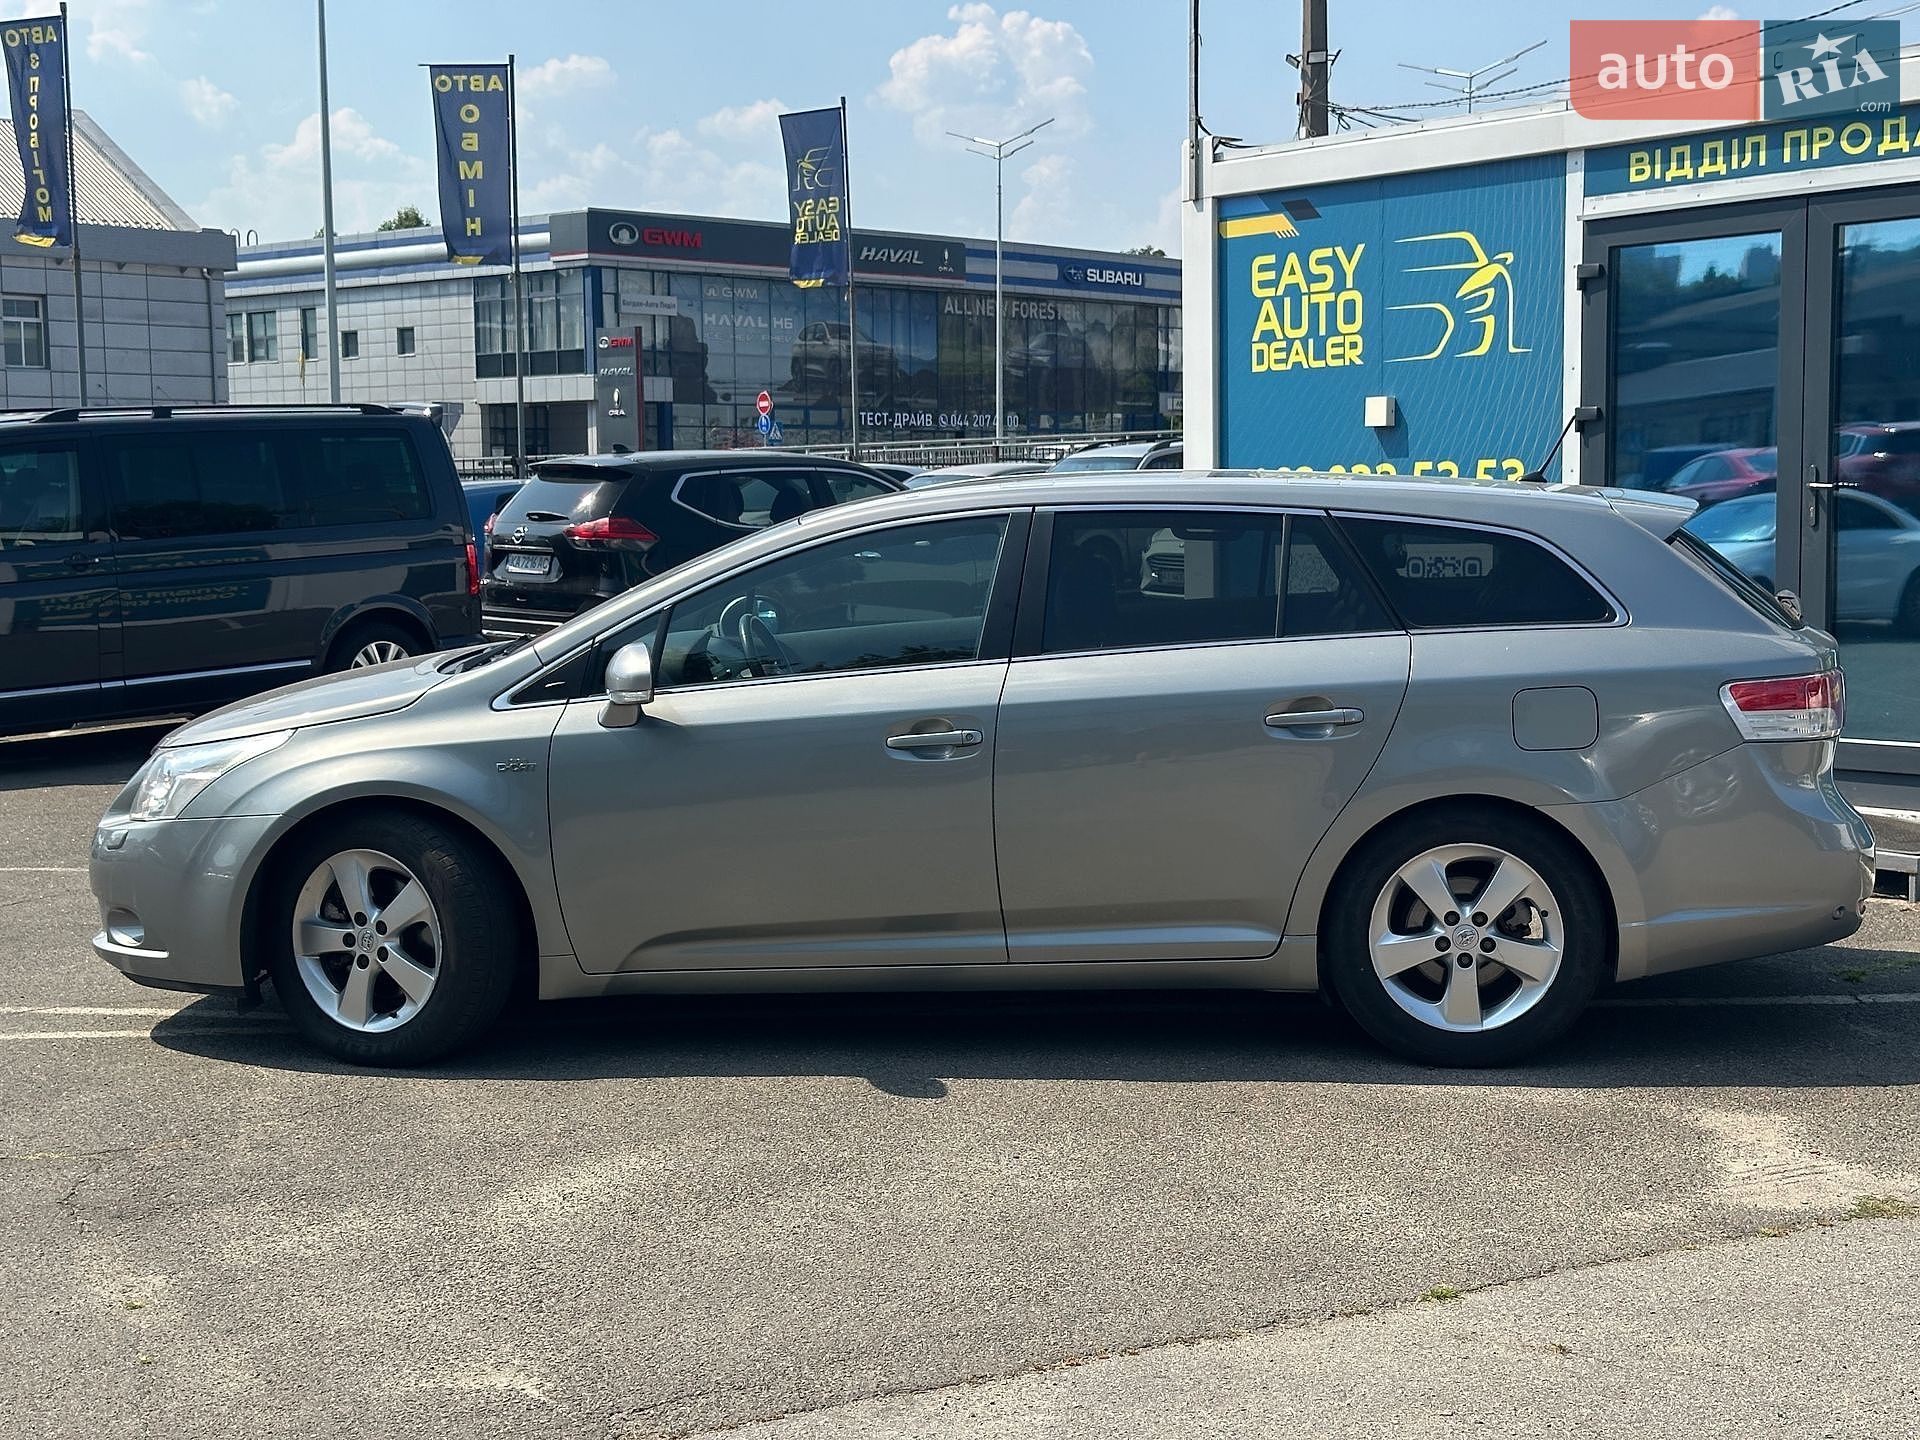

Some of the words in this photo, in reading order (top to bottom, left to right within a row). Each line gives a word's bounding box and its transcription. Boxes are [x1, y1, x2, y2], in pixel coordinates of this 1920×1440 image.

[1628, 134, 1767, 183] ВІДДІЛ
[1783, 115, 1920, 164] ПРОД
[643, 227, 703, 248] GWM
[859, 247, 925, 265] HAVAL
[1086, 268, 1143, 286] SUBARU
[1251, 243, 1366, 298] EASY
[721, 287, 758, 299] GWM
[944, 295, 972, 315] ALL
[704, 312, 769, 328] HAVAL
[772, 317, 793, 329] H6
[1251, 290, 1363, 342] AUTO
[610, 336, 634, 348] GWM
[1251, 334, 1364, 373] DEALER
[600, 367, 634, 376] HAVAL
[608, 409, 626, 417] ORA
[859, 411, 933, 428] ТЕСТ-ДРАЙВ
[950, 415, 969, 427] 044
[973, 415, 991, 427] 207
[1007, 415, 1019, 427] 00
